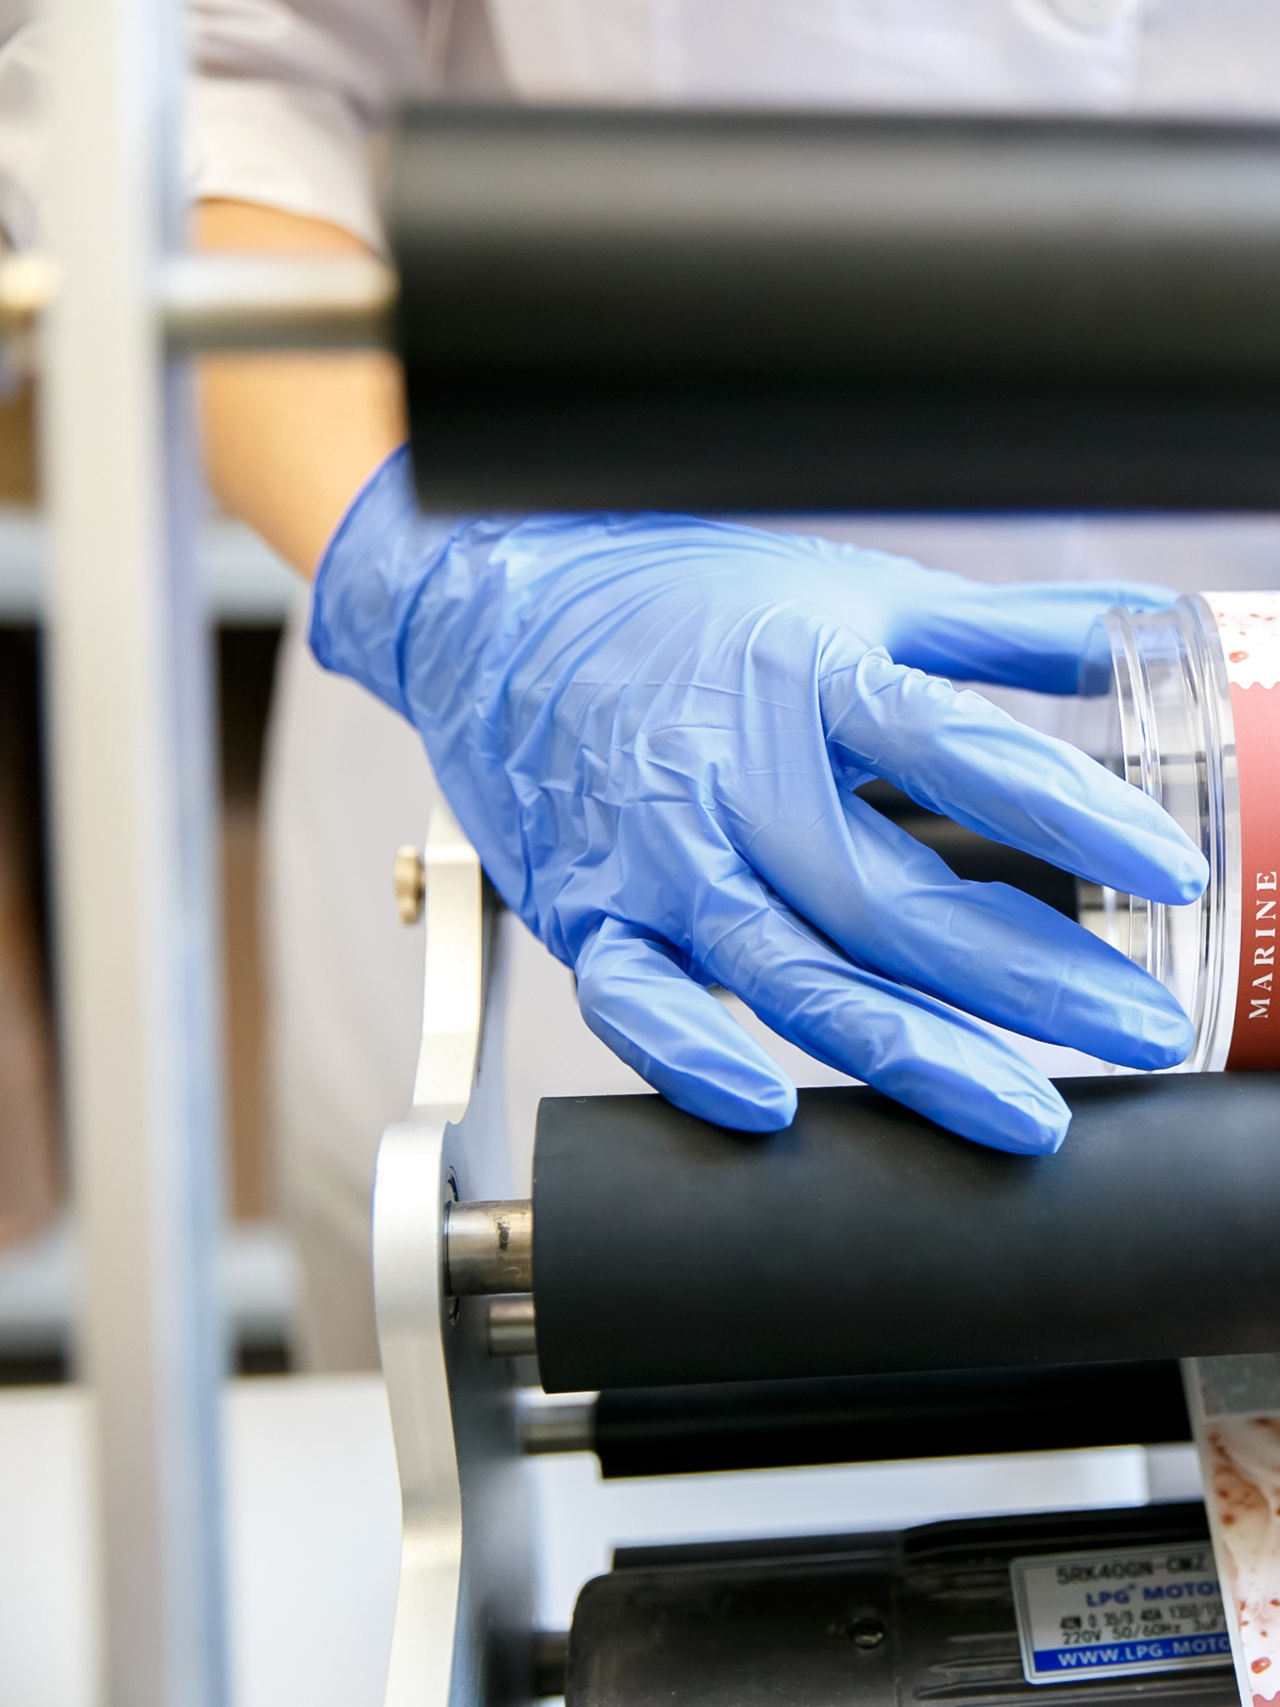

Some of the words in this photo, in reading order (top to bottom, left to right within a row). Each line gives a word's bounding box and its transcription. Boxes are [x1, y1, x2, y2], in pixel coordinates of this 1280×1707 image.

[1249, 871, 1277, 1019] MARINE
[1062, 1630, 1102, 1645] 220V
[1112, 1624, 1182, 1640] 50/60Hz
